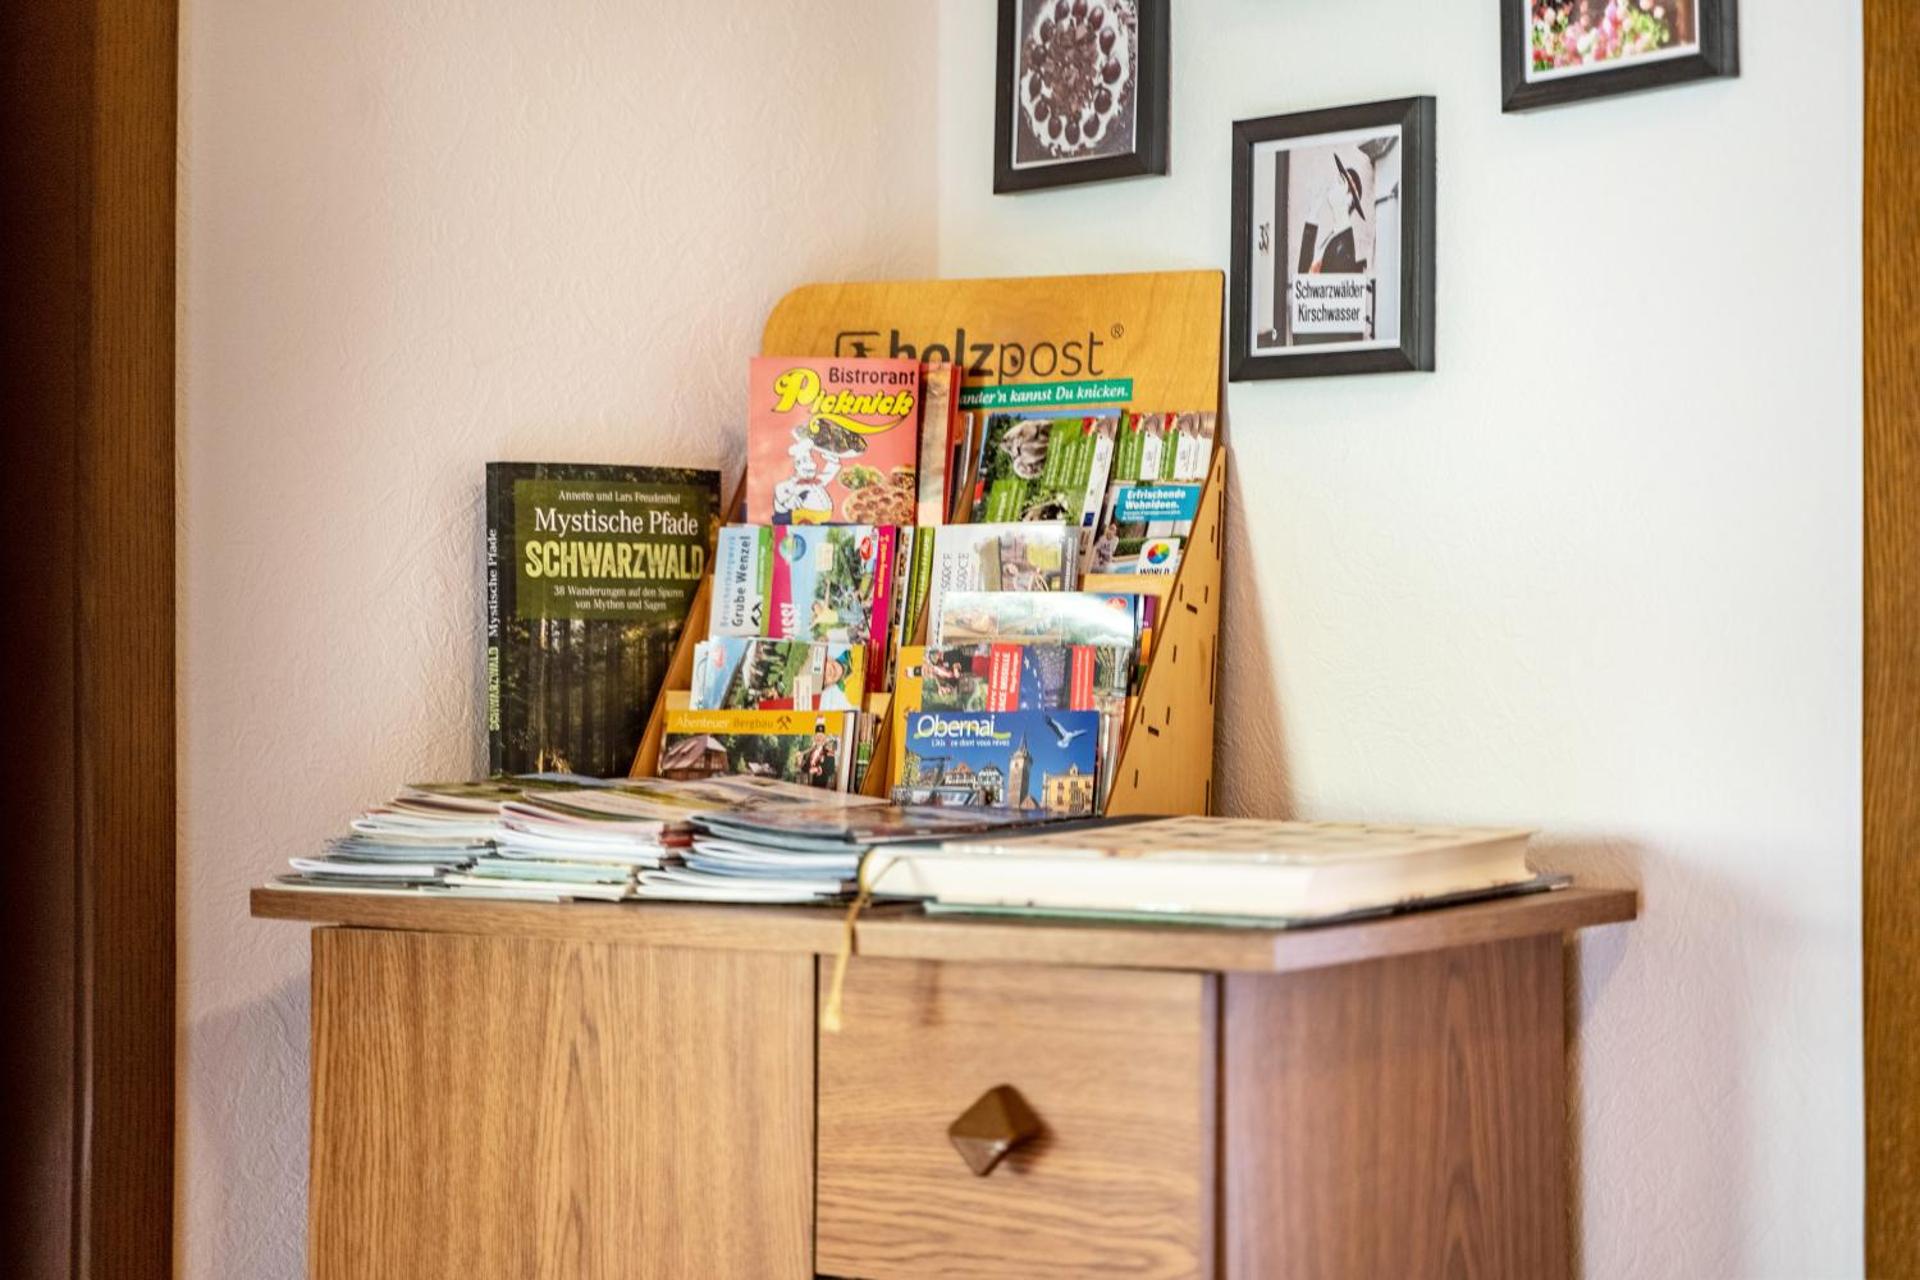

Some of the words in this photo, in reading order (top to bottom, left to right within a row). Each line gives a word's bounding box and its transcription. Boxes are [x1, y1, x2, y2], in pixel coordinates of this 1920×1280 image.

[1295, 279, 1365, 299] Schwarzwälder
[1298, 303, 1360, 323] Kirschwasser
[828, 366, 915, 385] Bistrorant
[772, 367, 915, 417] Picknick
[1010, 389, 1052, 402] kannst
[1056, 385, 1074, 400] Du
[1077, 383, 1129, 399] knicken.
[558, 490, 594, 501] Annette
[596, 491, 613, 502] und
[614, 491, 633, 503] Lars
[1127, 488, 1187, 500] Erfrischende
[1125, 500, 1180, 510] Wohnideen.
[534, 507, 644, 537] Mystische
[649, 510, 699, 535] Pfade
[487, 528, 498, 567] Pfade
[525, 540, 704, 580] SCHWARZWALD
[735, 535, 752, 584] Wenzel
[487, 567, 500, 638] Mystische
[553, 585, 565, 596] 38
[568, 585, 627, 599] Wanderungen
[628, 586, 641, 597] auf
[642, 587, 656, 597] den
[658, 587, 684, 600] Spuren
[575, 600, 591, 610] von
[593, 599, 625, 612] Mythen
[626, 600, 642, 610] und
[644, 600, 667, 612] Sagen
[731, 587, 746, 627] Grube
[488, 646, 500, 731] SCHWARZWALD
[679, 713, 729, 729] Abenteuer
[733, 717, 774, 730] Bergbau
[917, 713, 995, 738] Obernai
